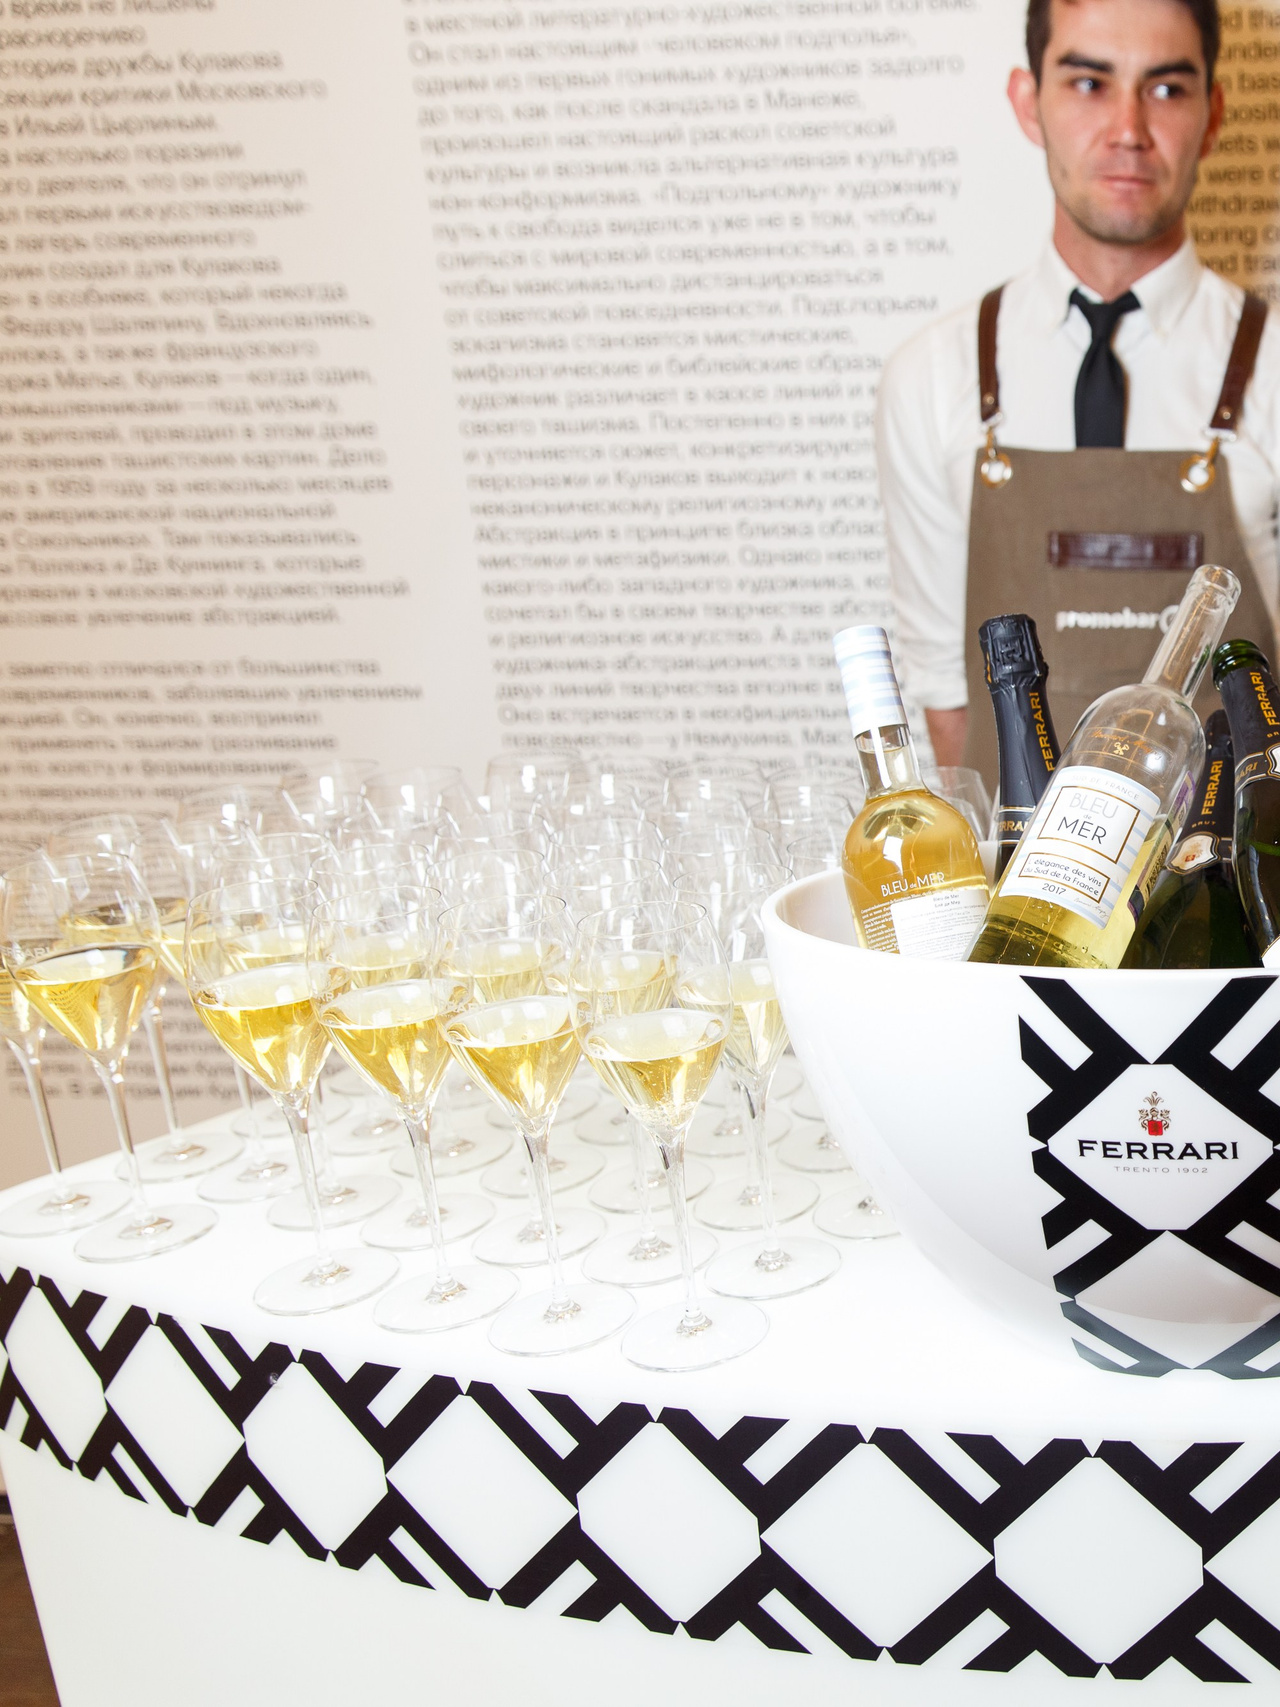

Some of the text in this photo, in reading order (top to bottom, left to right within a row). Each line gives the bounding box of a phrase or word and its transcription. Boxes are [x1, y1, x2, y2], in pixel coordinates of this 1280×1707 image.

[1250, 671, 1280, 727] FERRARI
[1028, 692, 1056, 773] FERRARI
[1105, 781, 1140, 801] FRANCE
[1201, 760, 1224, 816] FERRARI
[1069, 792, 1119, 819] BLEU
[1083, 813, 1093, 821] de
[1057, 816, 1107, 845] MER
[880, 878, 909, 898] BLEU
[916, 871, 945, 889] MER
[1033, 866, 1049, 875] Sud
[1050, 869, 1061, 878] de
[1062, 873, 1071, 882] la
[1072, 877, 1099, 896] France
[1041, 882, 1067, 895] 2017
[1071, 867, 1086, 879] des
[1088, 875, 1102, 887] vins
[1077, 1139, 1240, 1161] FERRARI
[1113, 1165, 1208, 1174] TRENTO 1902
